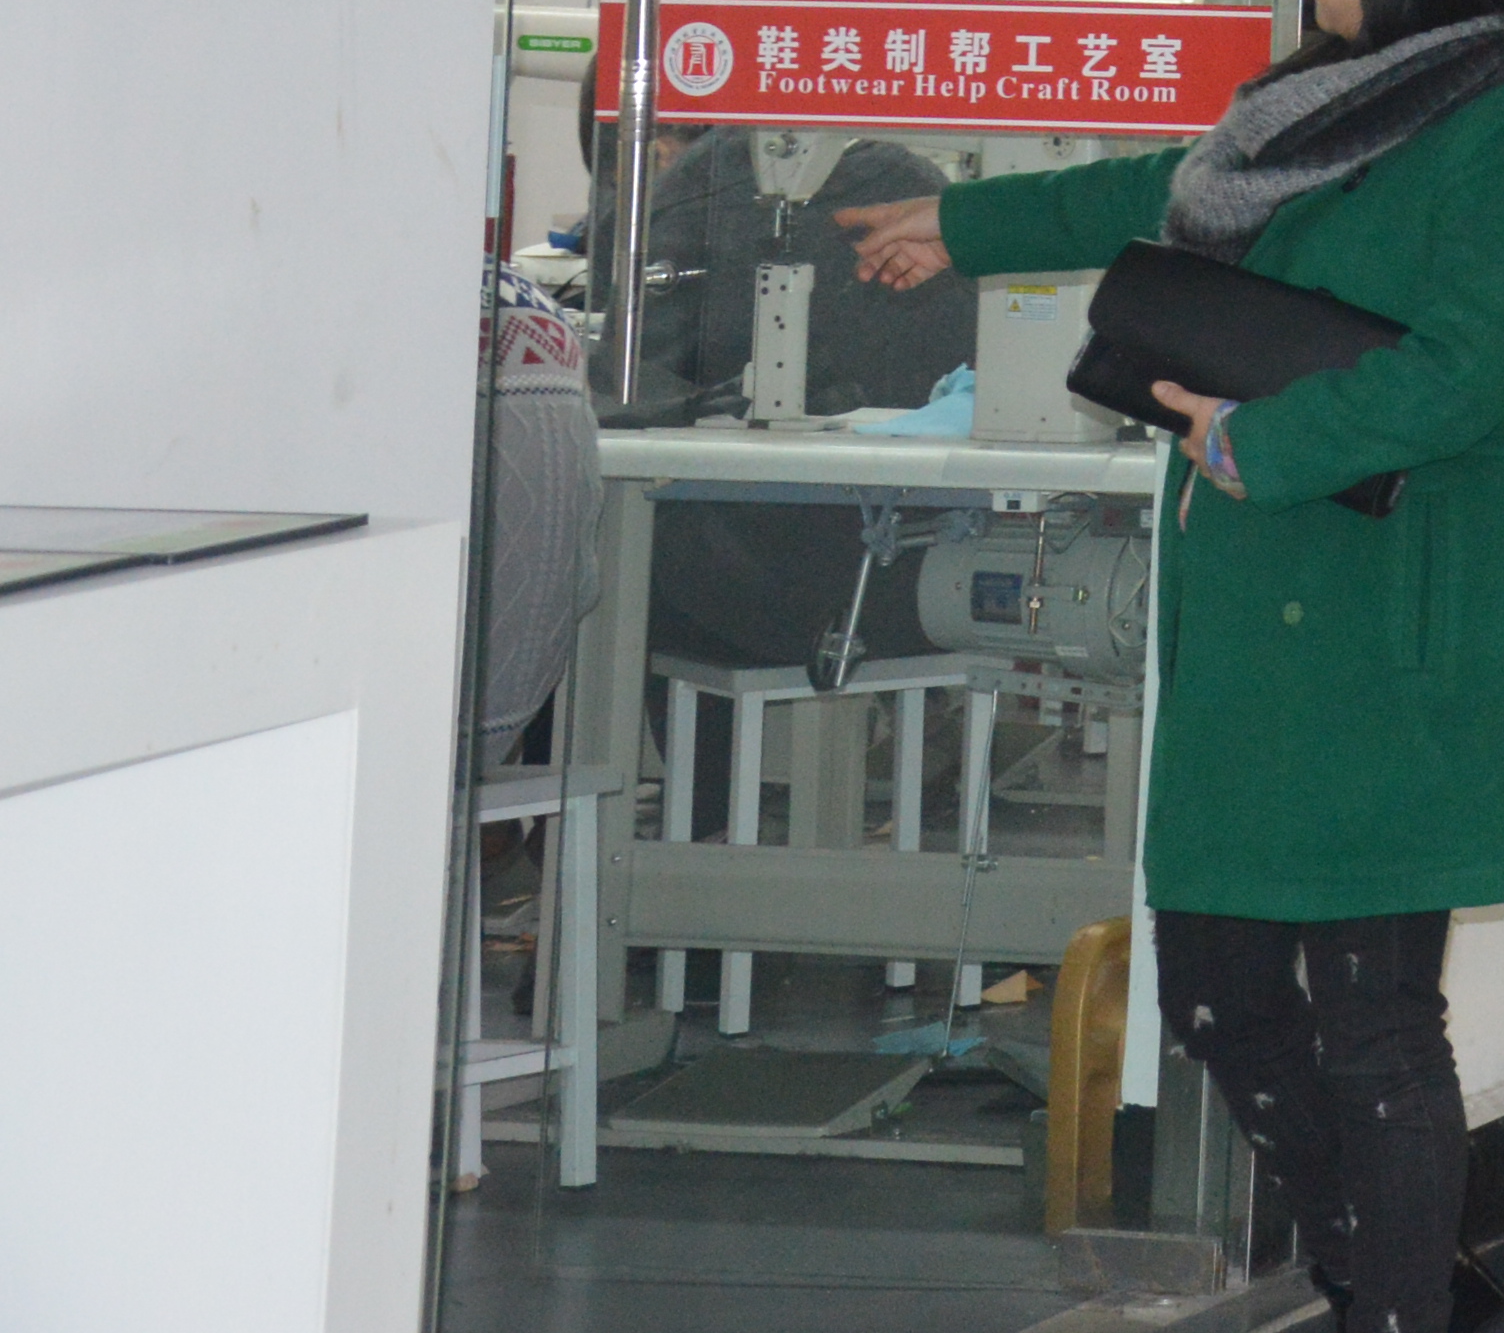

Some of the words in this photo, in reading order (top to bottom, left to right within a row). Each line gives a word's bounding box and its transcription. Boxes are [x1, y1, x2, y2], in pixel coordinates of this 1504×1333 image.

[756, 25, 1182, 80] 鞋类制帮工艺室
[757, 69, 905, 97] Footwear
[914, 73, 987, 104] Help
[996, 75, 1080, 101] Craft
[1089, 77, 1178, 103] Room
